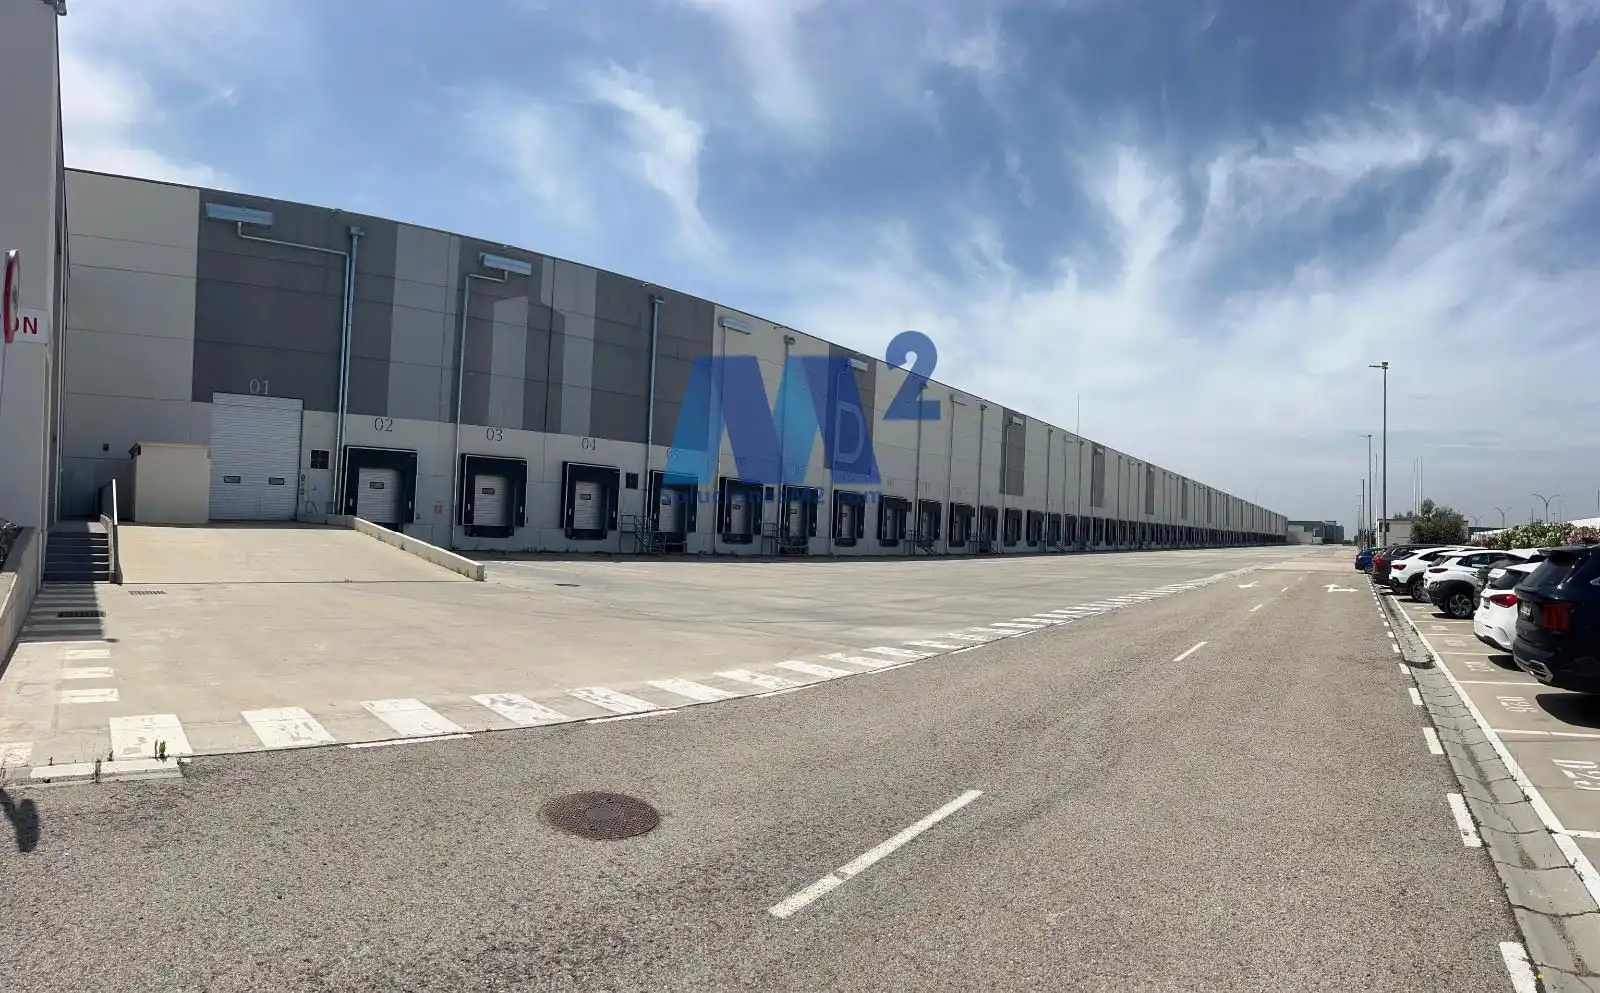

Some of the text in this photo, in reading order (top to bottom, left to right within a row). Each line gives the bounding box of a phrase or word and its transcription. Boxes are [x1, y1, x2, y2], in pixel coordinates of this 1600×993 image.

[249, 378, 270, 395] 01
[374, 417, 393, 432] 02
[486, 426, 504, 442] 03
[581, 437, 596, 451] 04
